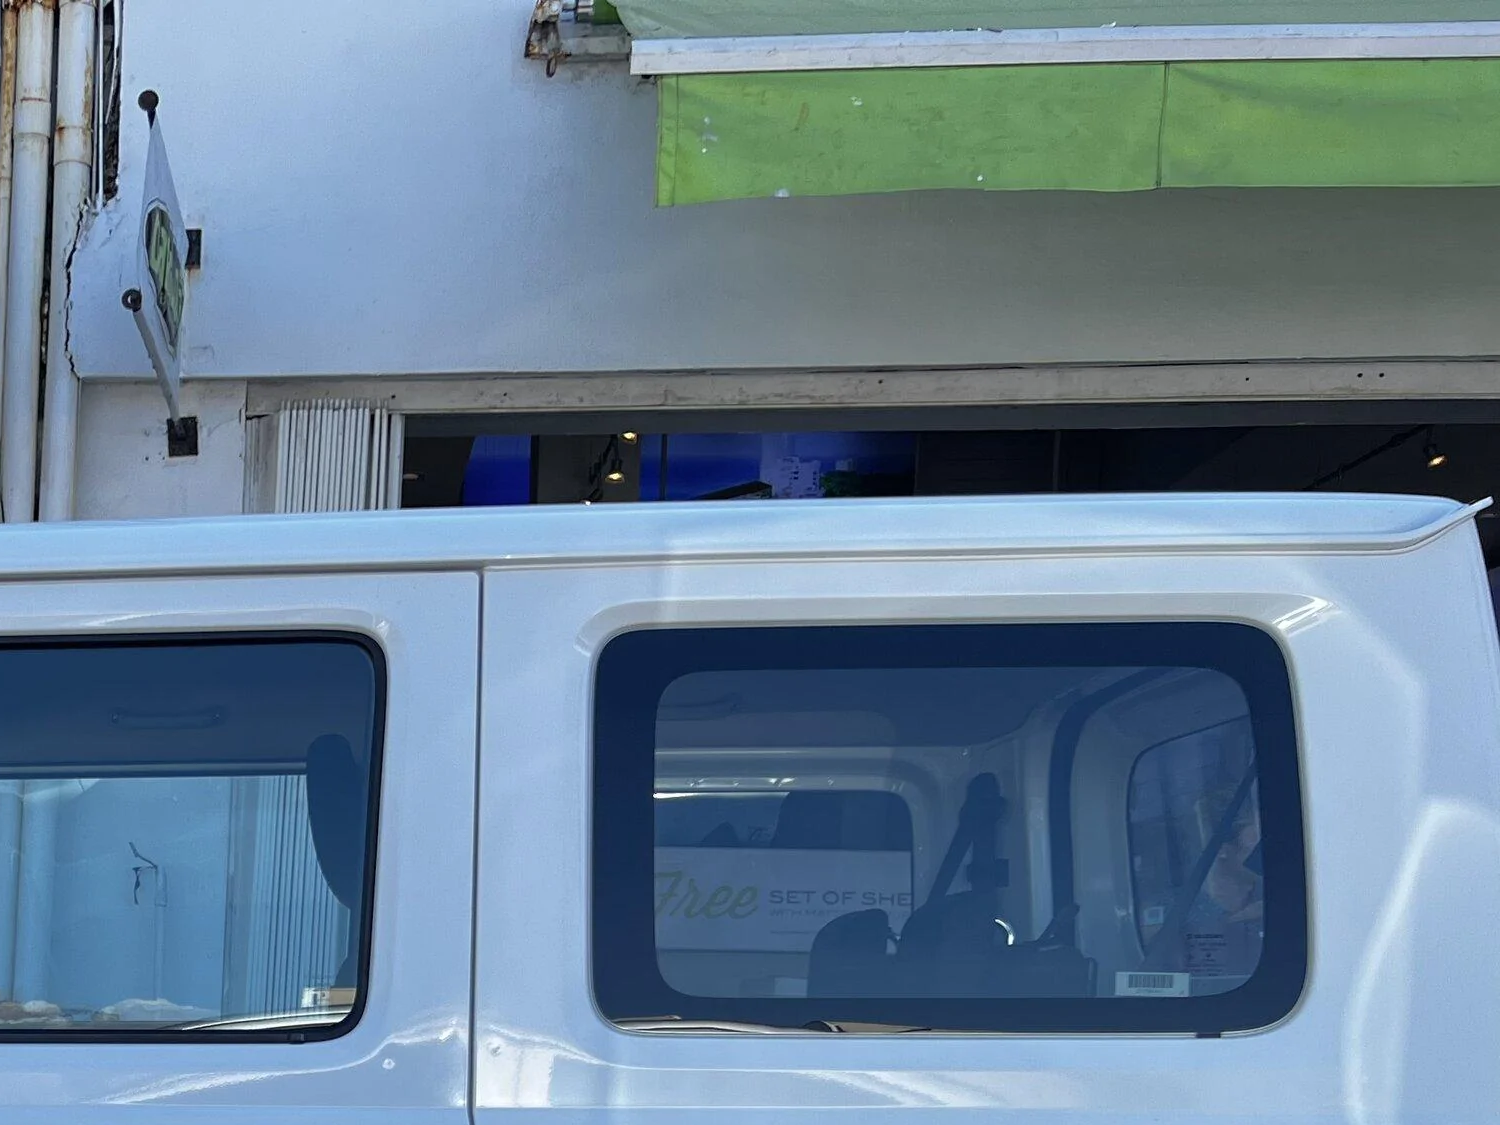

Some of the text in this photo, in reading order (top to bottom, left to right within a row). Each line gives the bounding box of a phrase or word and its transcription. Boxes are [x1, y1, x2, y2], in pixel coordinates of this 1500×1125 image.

[653, 870, 759, 919] Free
[769, 890, 817, 904] SET
[822, 890, 856, 905] OF
